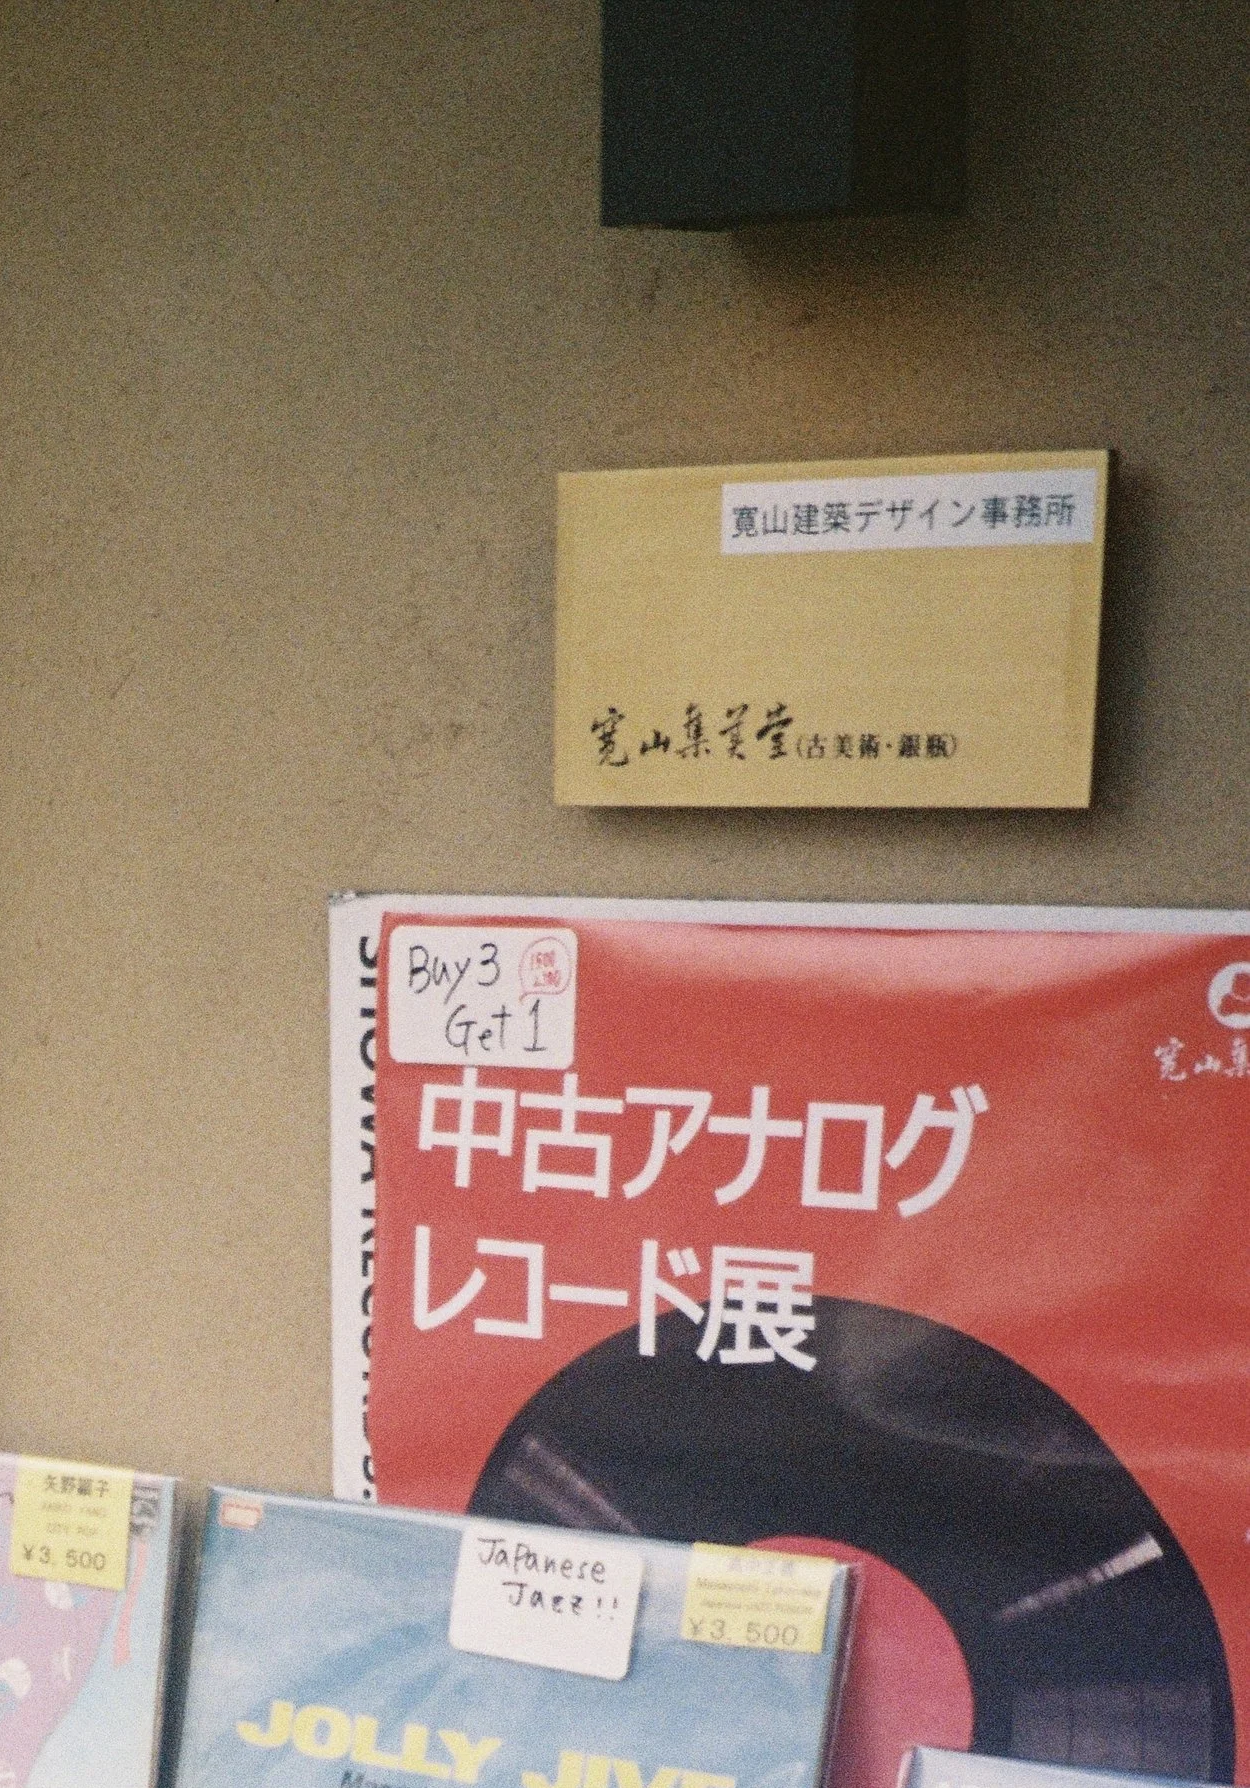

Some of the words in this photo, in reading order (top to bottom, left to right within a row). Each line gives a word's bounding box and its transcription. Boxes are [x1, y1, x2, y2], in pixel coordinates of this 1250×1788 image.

[731, 493, 1076, 538] 寛山建築デザイン事務所
[409, 944, 471, 1005] Buy
[477, 942, 500, 987] 3
[445, 1003, 512, 1057] Get
[523, 998, 547, 1052] 1
[418, 1067, 990, 1218] 中古アナログ
[410, 1224, 818, 1373] レコード展
[477, 1536, 606, 1586] Japanese
[235, 1698, 502, 1785] JOLLY
